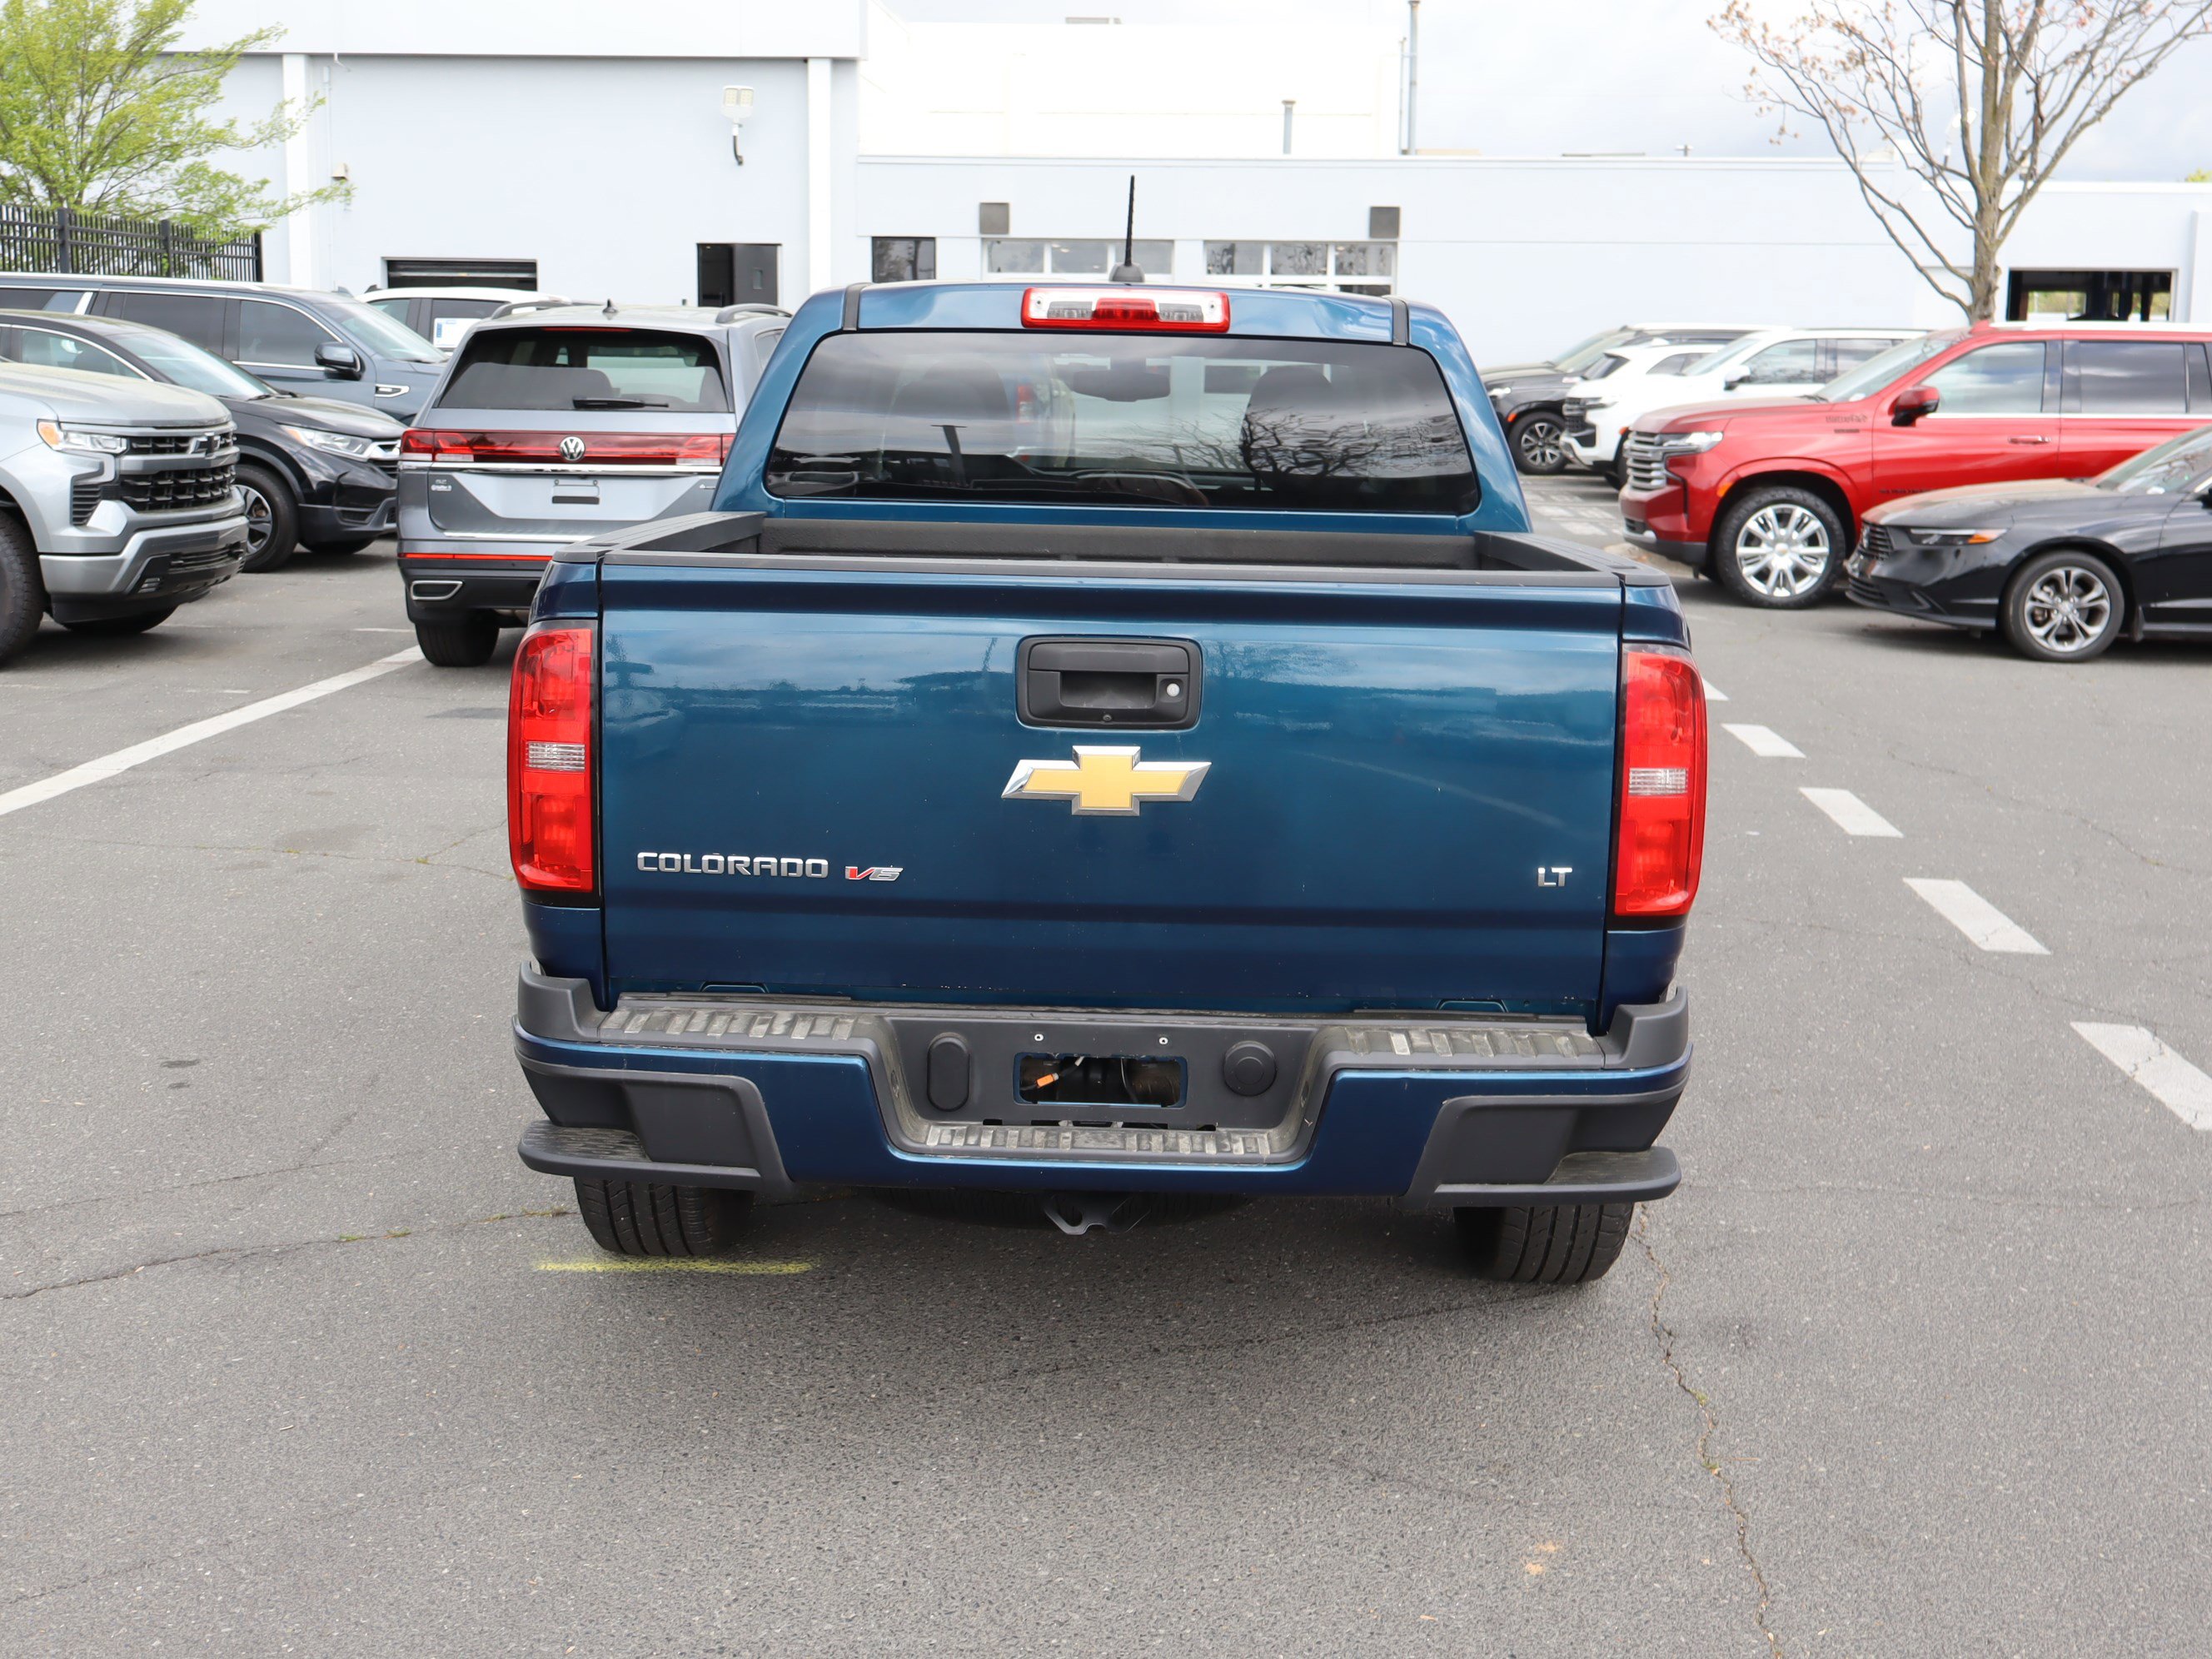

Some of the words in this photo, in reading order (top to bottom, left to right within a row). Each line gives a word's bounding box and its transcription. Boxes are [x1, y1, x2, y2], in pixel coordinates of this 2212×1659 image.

[560, 436, 585, 461] VW
[637, 852, 829, 879] COLORADO
[844, 865, 904, 881] V6
[1537, 867, 1573, 887] LT
